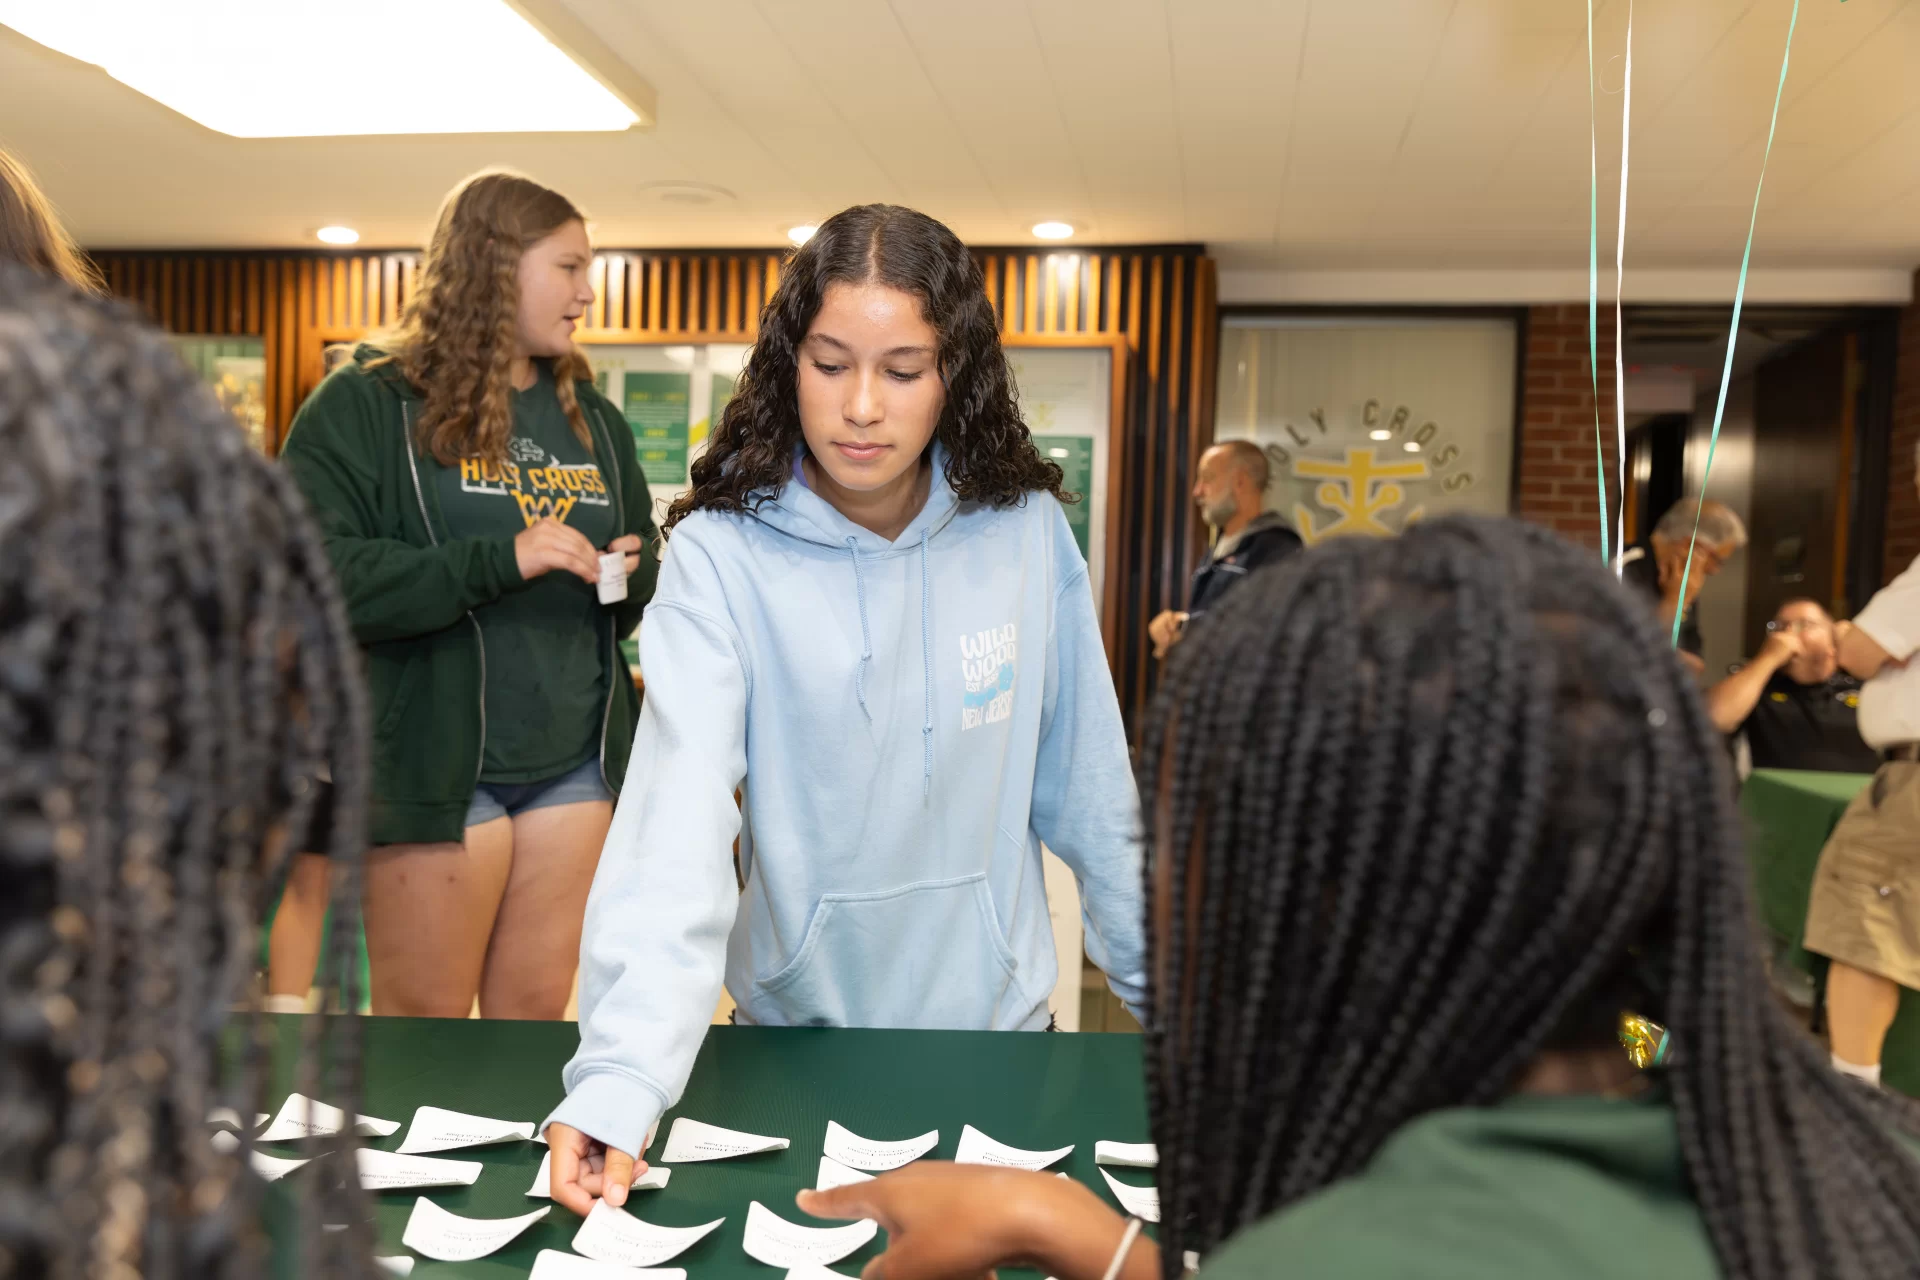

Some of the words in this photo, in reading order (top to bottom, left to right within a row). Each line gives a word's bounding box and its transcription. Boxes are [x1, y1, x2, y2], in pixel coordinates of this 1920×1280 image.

[1265, 407, 1328, 467] OLY
[1362, 398, 1474, 492] CROSS
[527, 467, 606, 494] CROSS
[959, 623, 1016, 660] WILD
[961, 643, 1015, 682] WOOD
[962, 706, 984, 732] NEW
[986, 690, 1013, 725] JERSE
